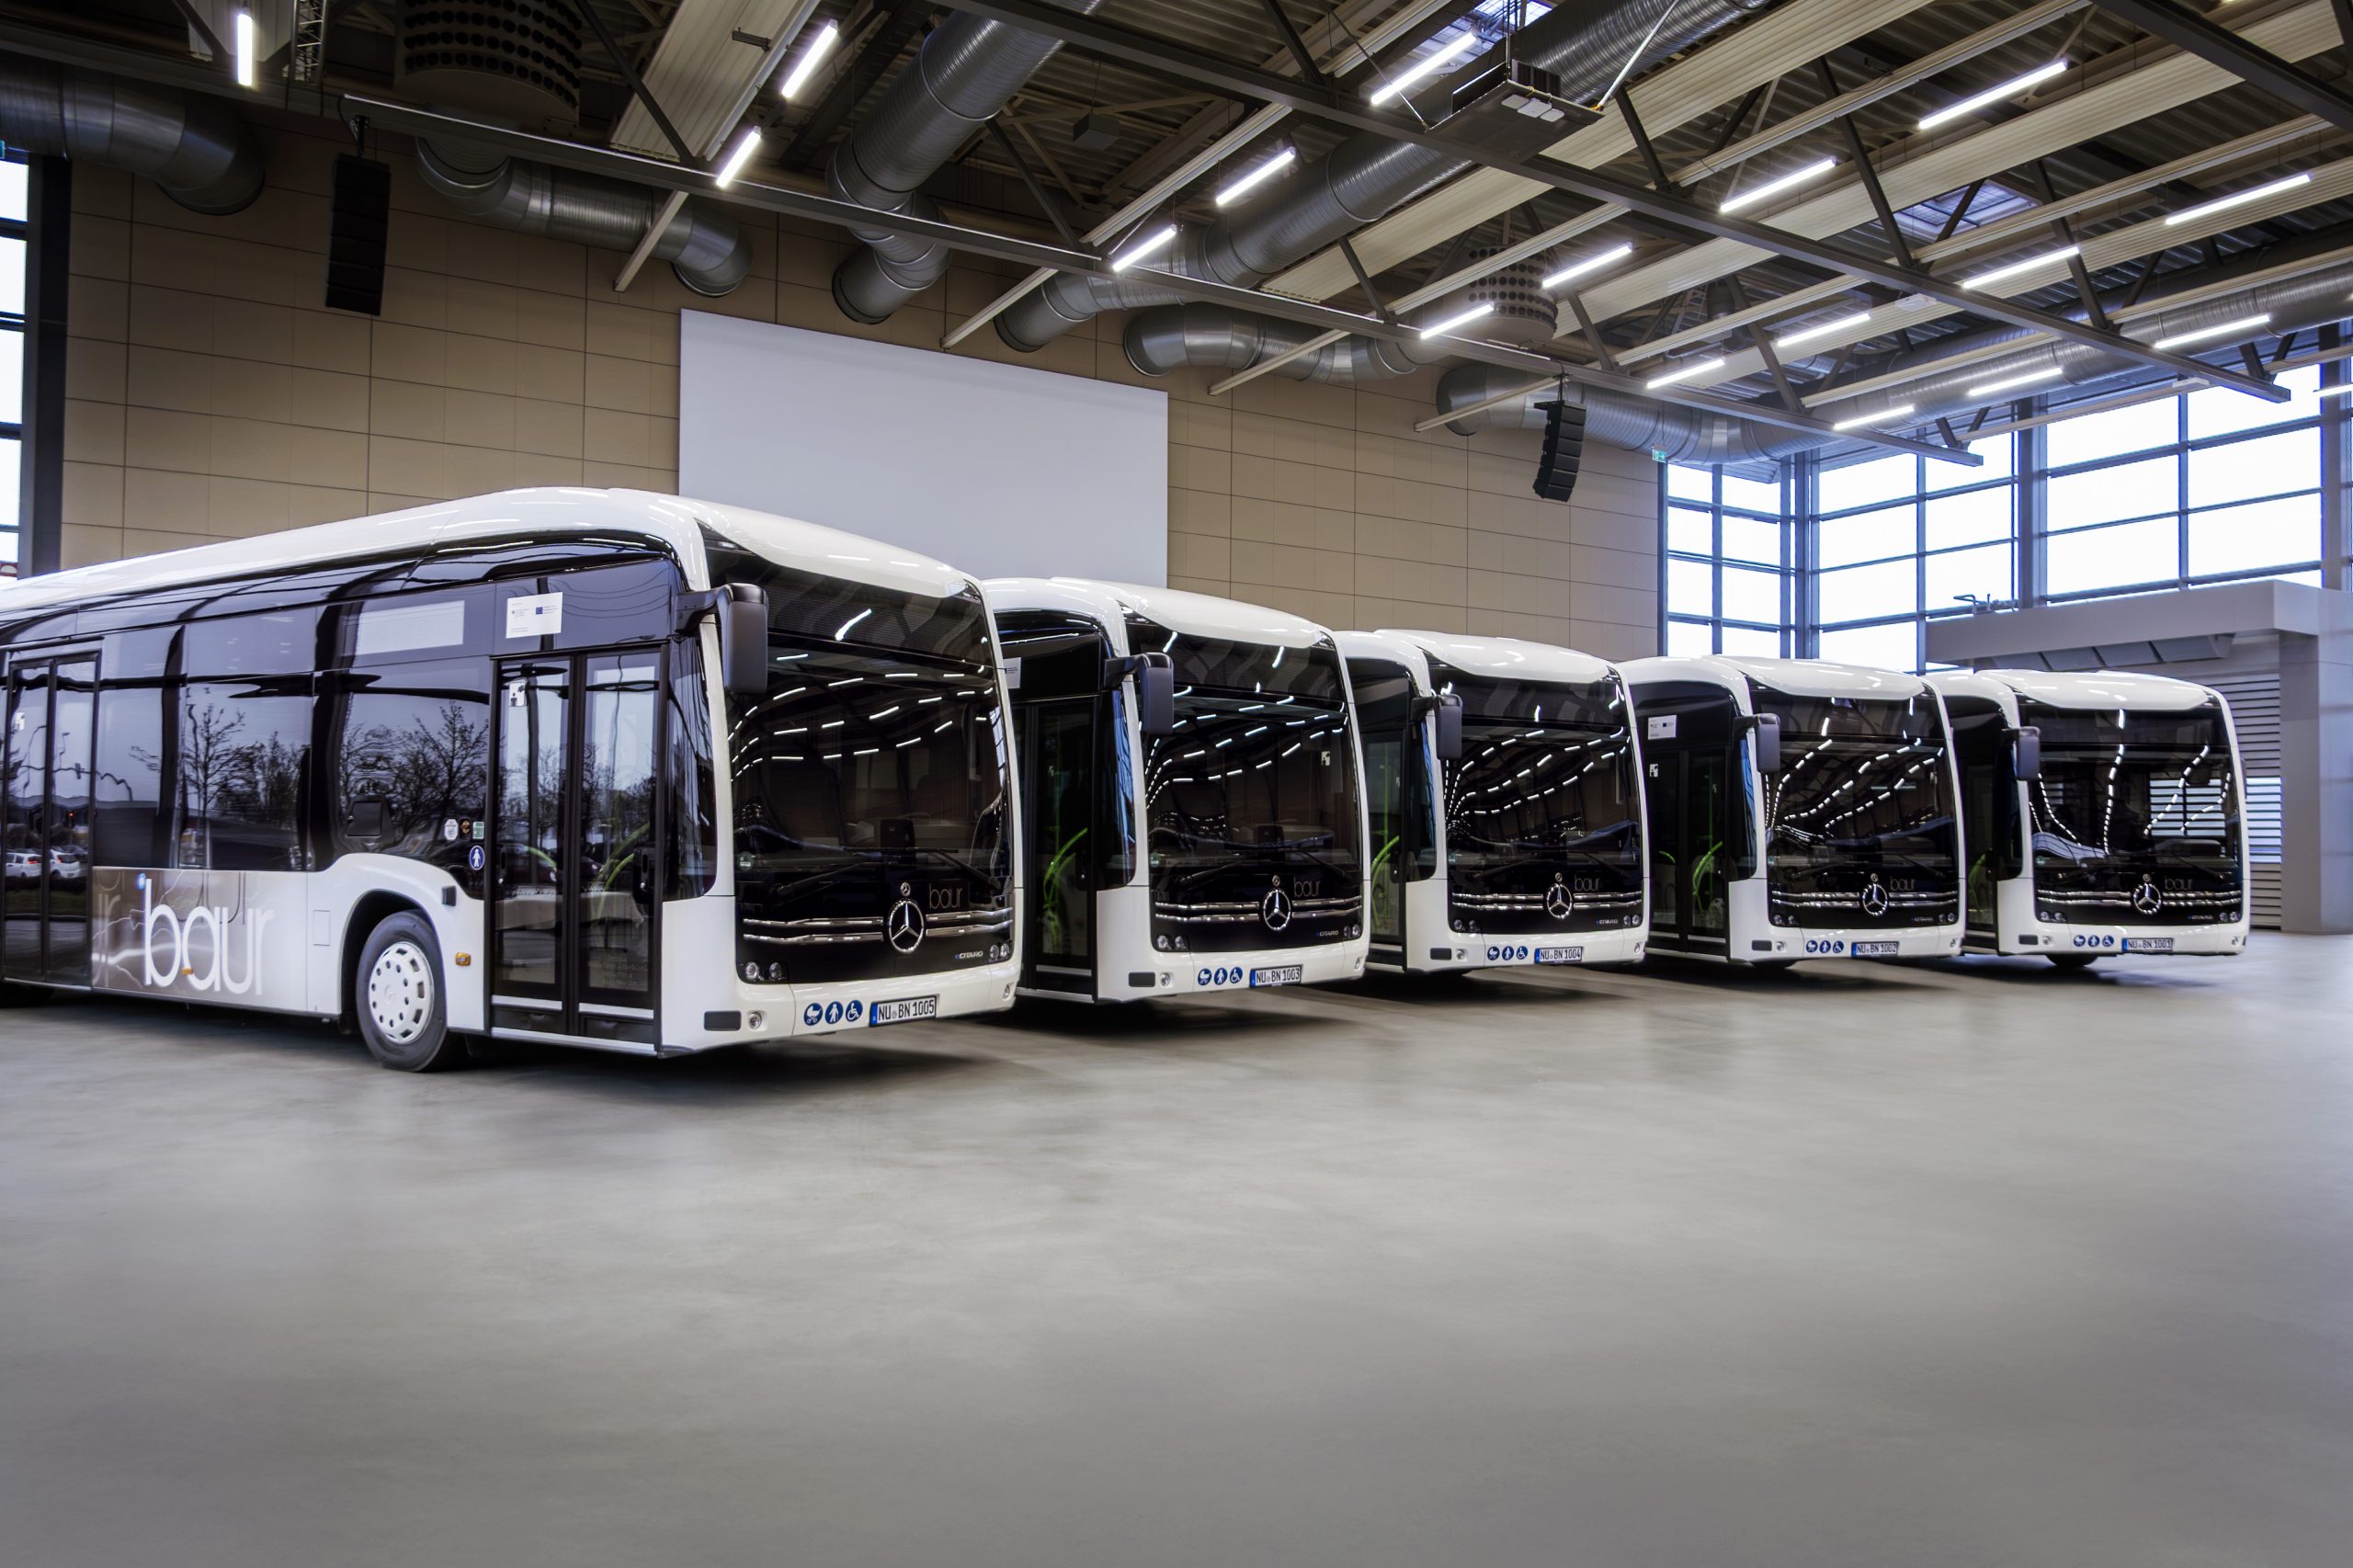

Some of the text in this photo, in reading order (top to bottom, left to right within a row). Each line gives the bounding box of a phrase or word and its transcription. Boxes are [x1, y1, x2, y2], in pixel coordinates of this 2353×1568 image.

[1293, 877, 1321, 898] baur
[1574, 874, 1600, 892] baur
[928, 882, 963, 910] baur
[144, 878, 276, 996] baur
[1540, 949, 1581, 960] NU BN 1004
[1256, 968, 1300, 983] NU BN 1003
[878, 999, 935, 1021] NU BN 1005
